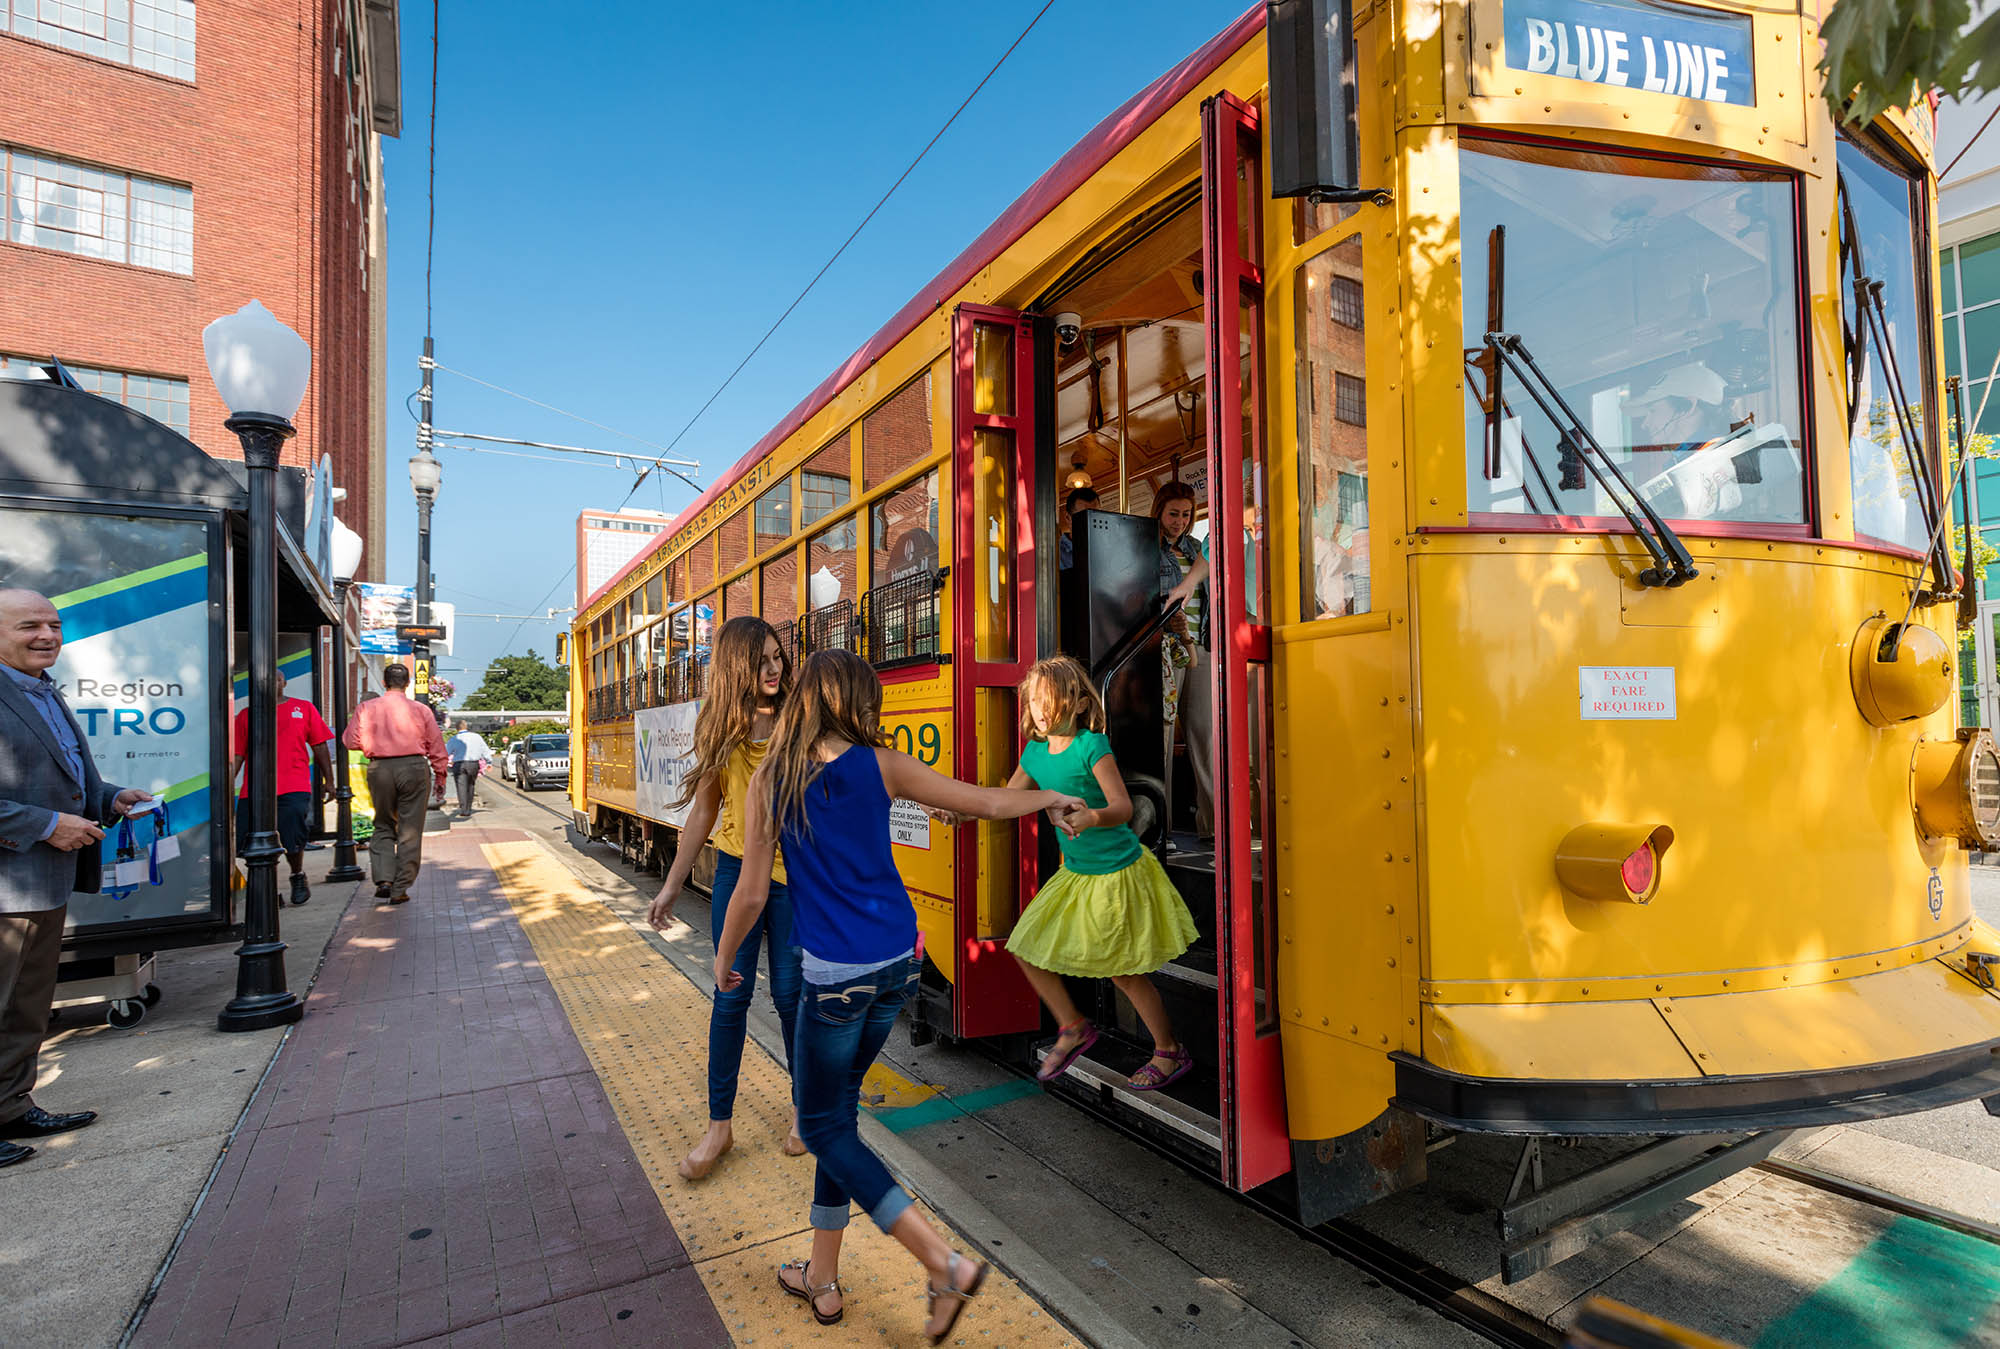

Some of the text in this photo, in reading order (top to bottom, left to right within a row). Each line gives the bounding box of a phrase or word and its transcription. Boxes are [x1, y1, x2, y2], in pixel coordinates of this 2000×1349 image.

[1526, 17, 1729, 103] BLUE LINE
[623, 456, 774, 590] CENTRAL ARKANSAS TRANSIT
[1602, 671, 1649, 681] EXACT
[77, 678, 184, 704] Region
[1611, 686, 1647, 697] FARE
[1593, 701, 1665, 714] REQUIRED
[76, 706, 186, 737] TRO
[657, 727, 692, 754] Rock Region
[879, 723, 941, 767] 09
[906, 813, 929, 822] BOARDING
[914, 823, 929, 831] STOPS
[897, 829, 913, 842] ONLY.
